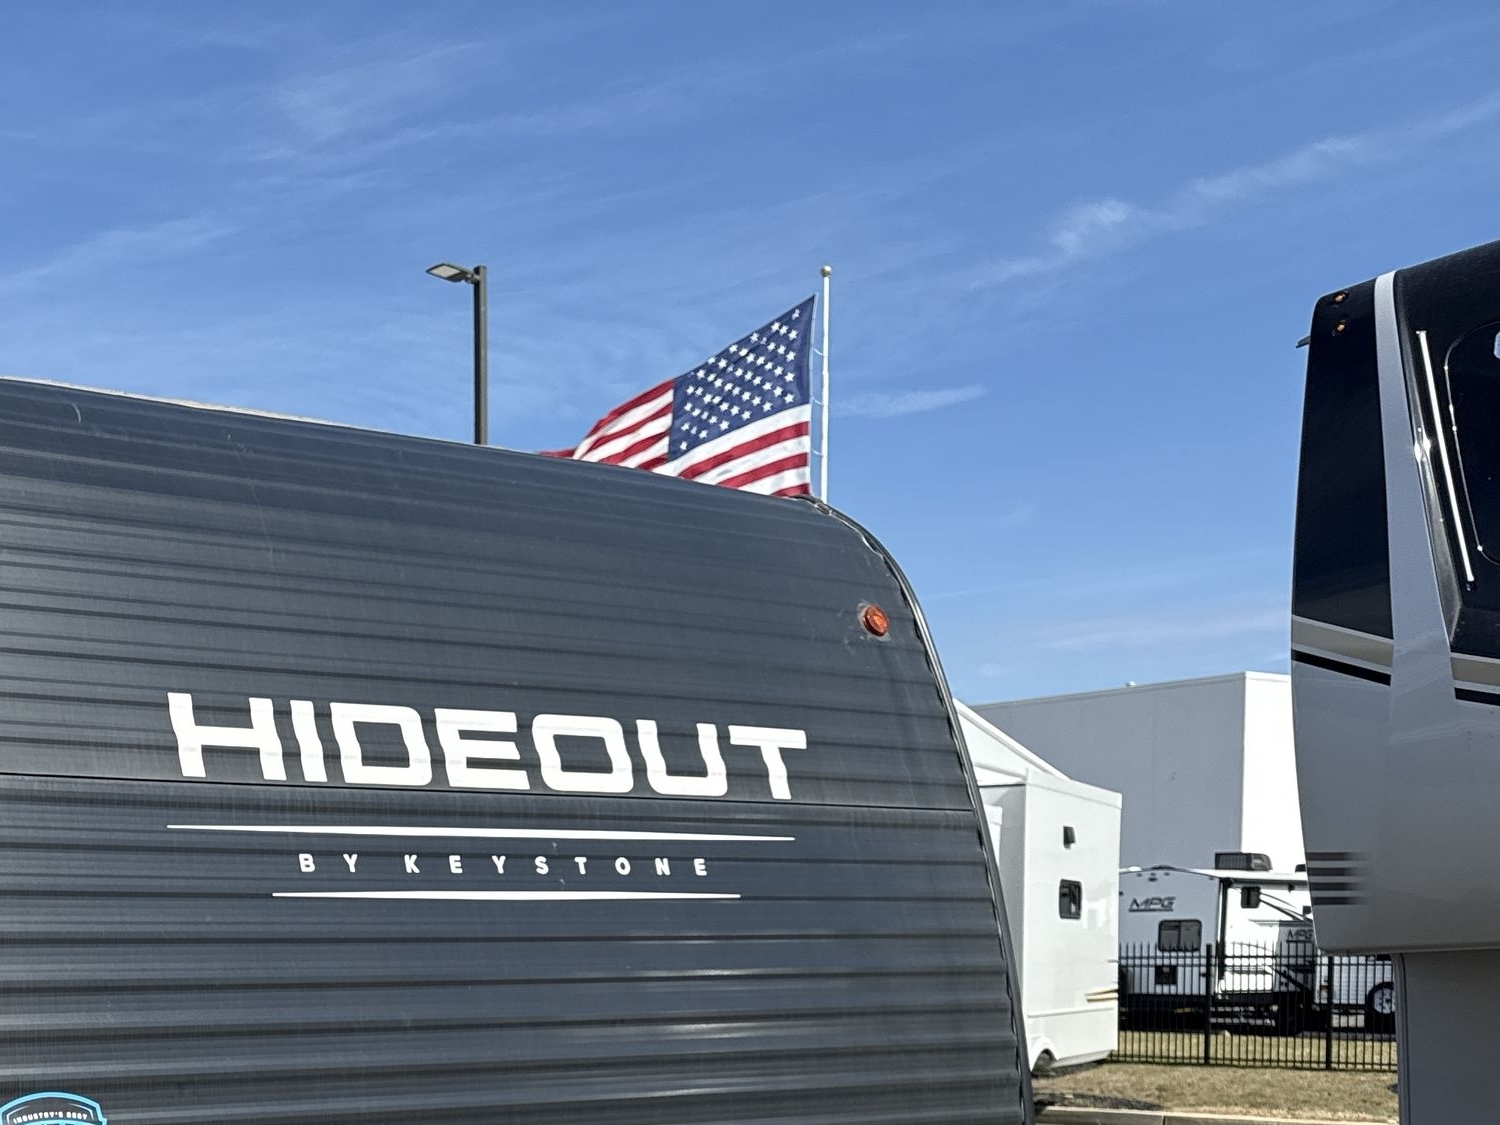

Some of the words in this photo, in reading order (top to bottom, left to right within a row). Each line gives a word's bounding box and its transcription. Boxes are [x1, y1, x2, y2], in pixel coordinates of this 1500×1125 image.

[167, 692, 807, 800] HIDEOUT
[299, 853, 359, 873] BY
[404, 854, 708, 877] KEYSTONE
[1128, 896, 1176, 912] MPG
